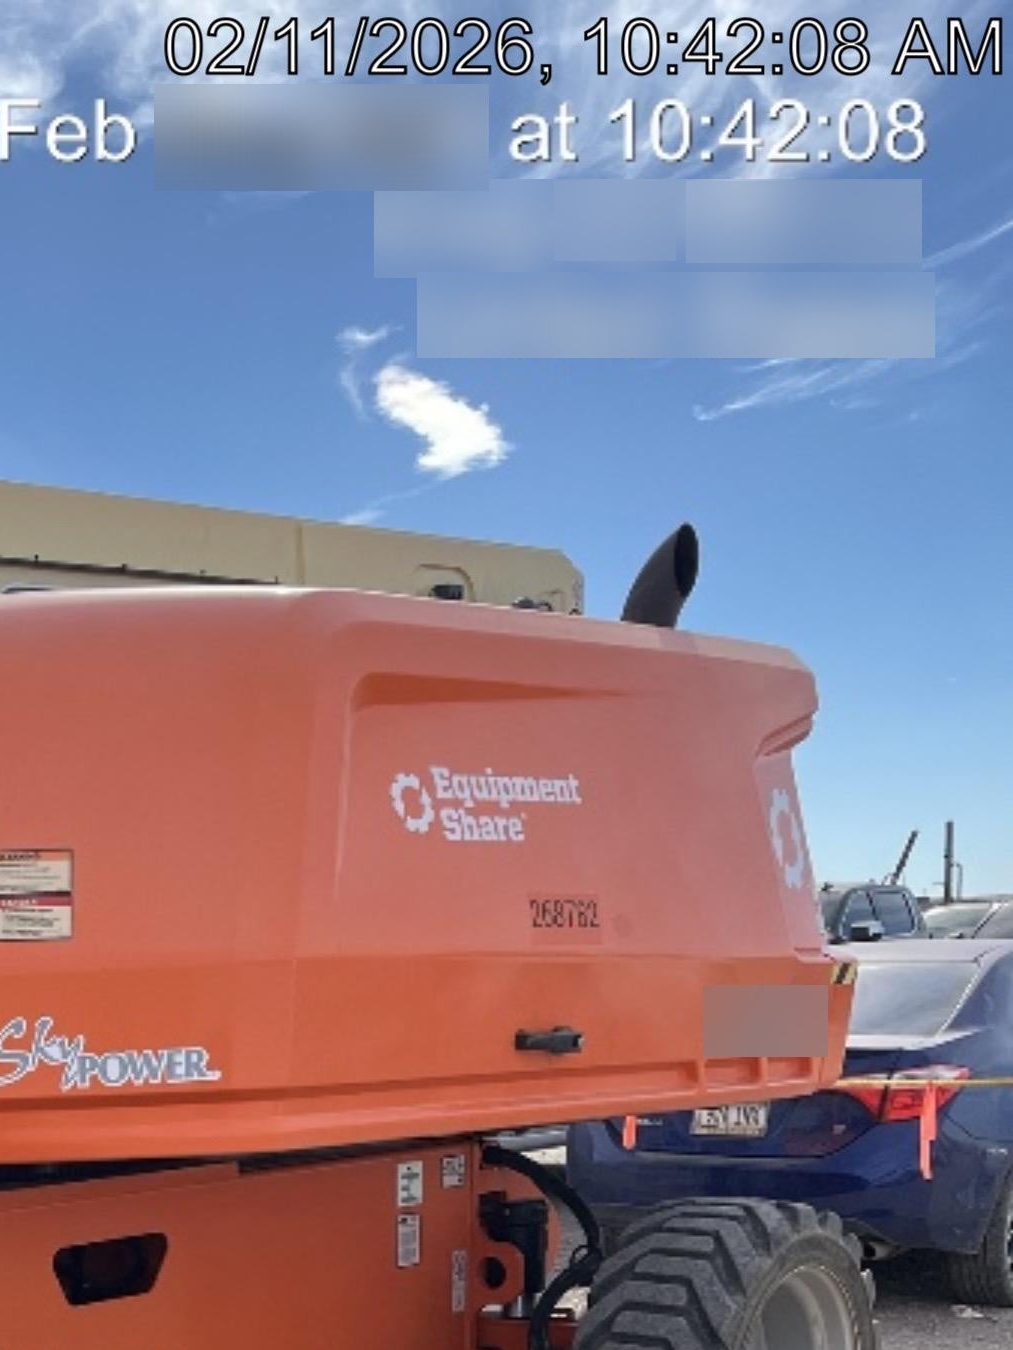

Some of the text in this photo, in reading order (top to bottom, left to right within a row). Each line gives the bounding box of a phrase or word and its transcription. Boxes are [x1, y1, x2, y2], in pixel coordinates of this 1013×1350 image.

[429, 766, 583, 808] Equipment
[440, 806, 526, 841] Share
[529, 899, 601, 929] 268782
